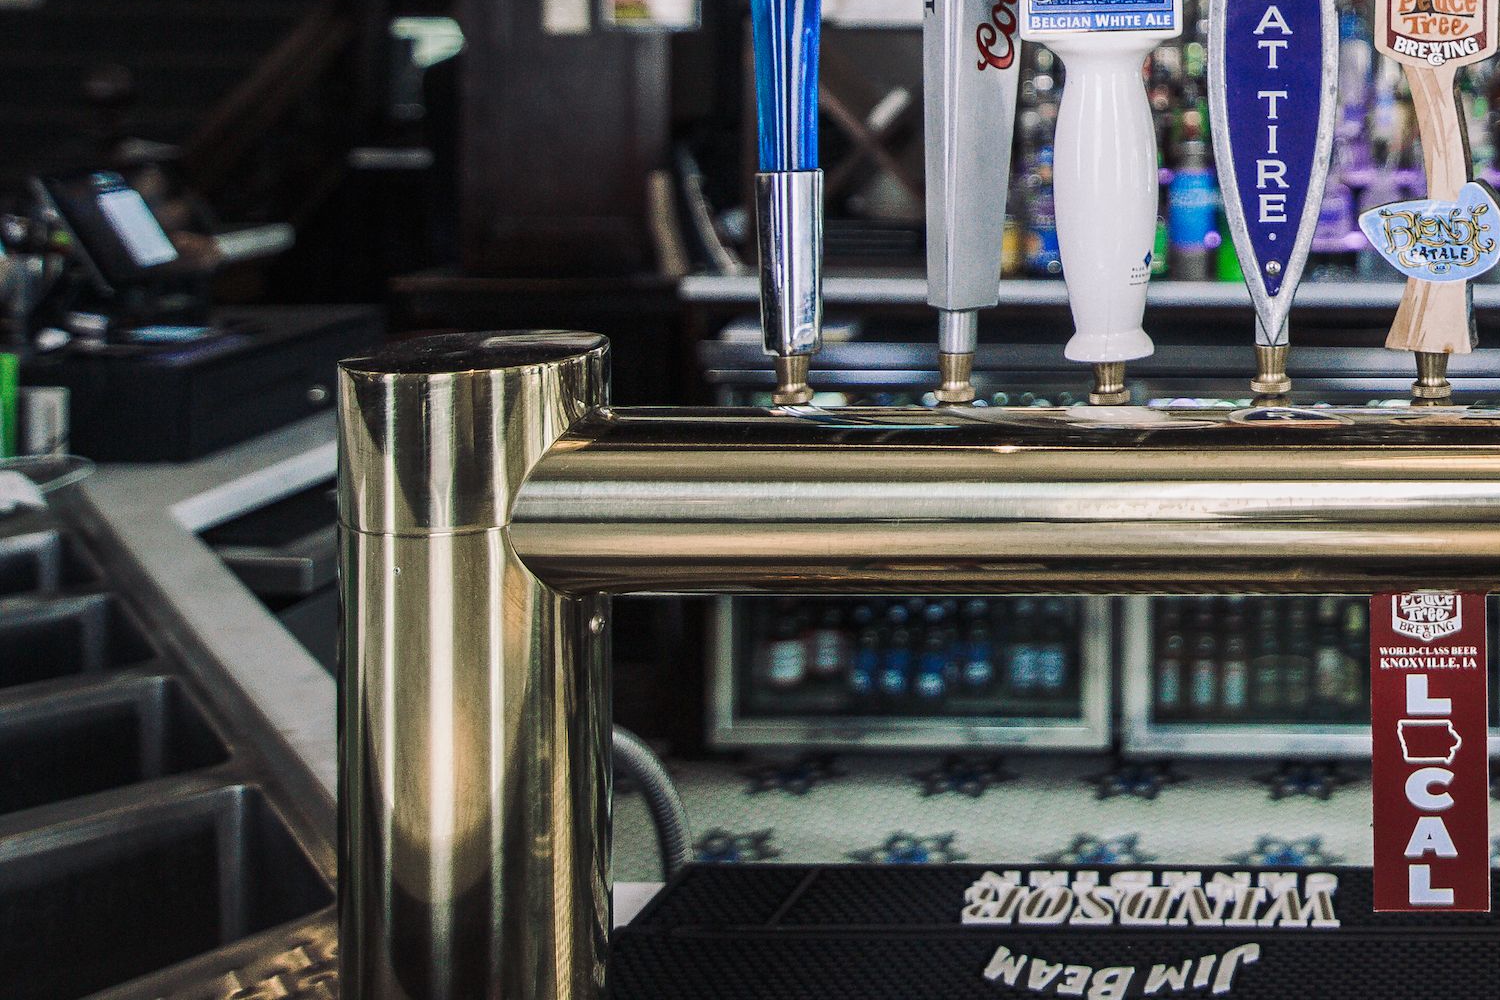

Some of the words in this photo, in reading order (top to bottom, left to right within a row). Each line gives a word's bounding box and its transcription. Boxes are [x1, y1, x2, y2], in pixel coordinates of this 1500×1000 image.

[1031, 12, 1093, 29] BELGIAN
[1095, 14, 1142, 28] WHITE
[1146, 12, 1171, 26] ALE
[1402, 14, 1470, 36] Tree
[1393, 34, 1480, 60] BREWING
[1256, 90, 1289, 223] TIRE
[1402, 606, 1450, 621] Tree
[1399, 620, 1455, 634] BREWING
[1379, 646, 1450, 656] WORLD-CLASS
[1451, 646, 1478, 656] BEER
[1380, 657, 1461, 670] KNOXVILLE,
[1462, 657, 1477, 669] IA
[961, 869, 1341, 928] WINDSOR
[983, 944, 1137, 1000] BEAM
[1143, 942, 1261, 995] JIM
